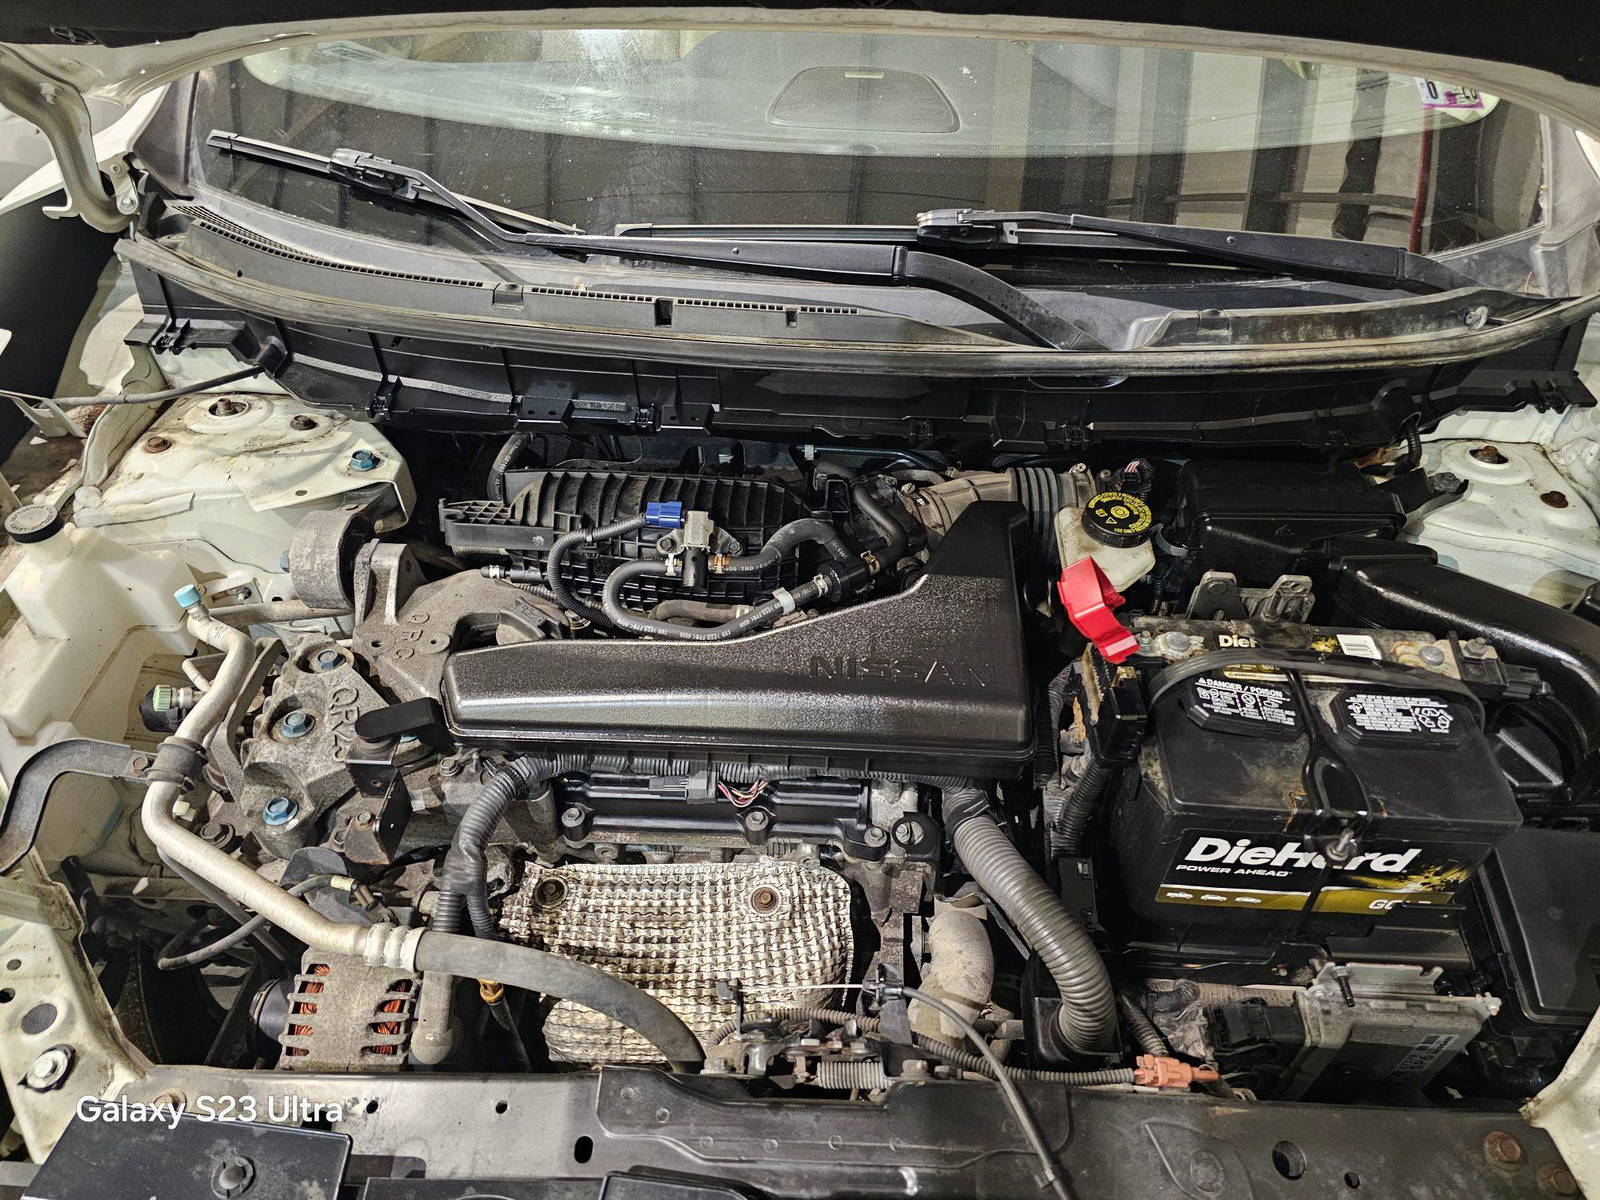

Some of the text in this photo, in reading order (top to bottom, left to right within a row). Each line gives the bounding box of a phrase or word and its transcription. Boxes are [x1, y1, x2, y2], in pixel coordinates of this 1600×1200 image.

[1206, 678, 1243, 692] DANGER
[1249, 686, 1284, 699] POISON
[1175, 864, 1290, 878] POWER AHEAD
